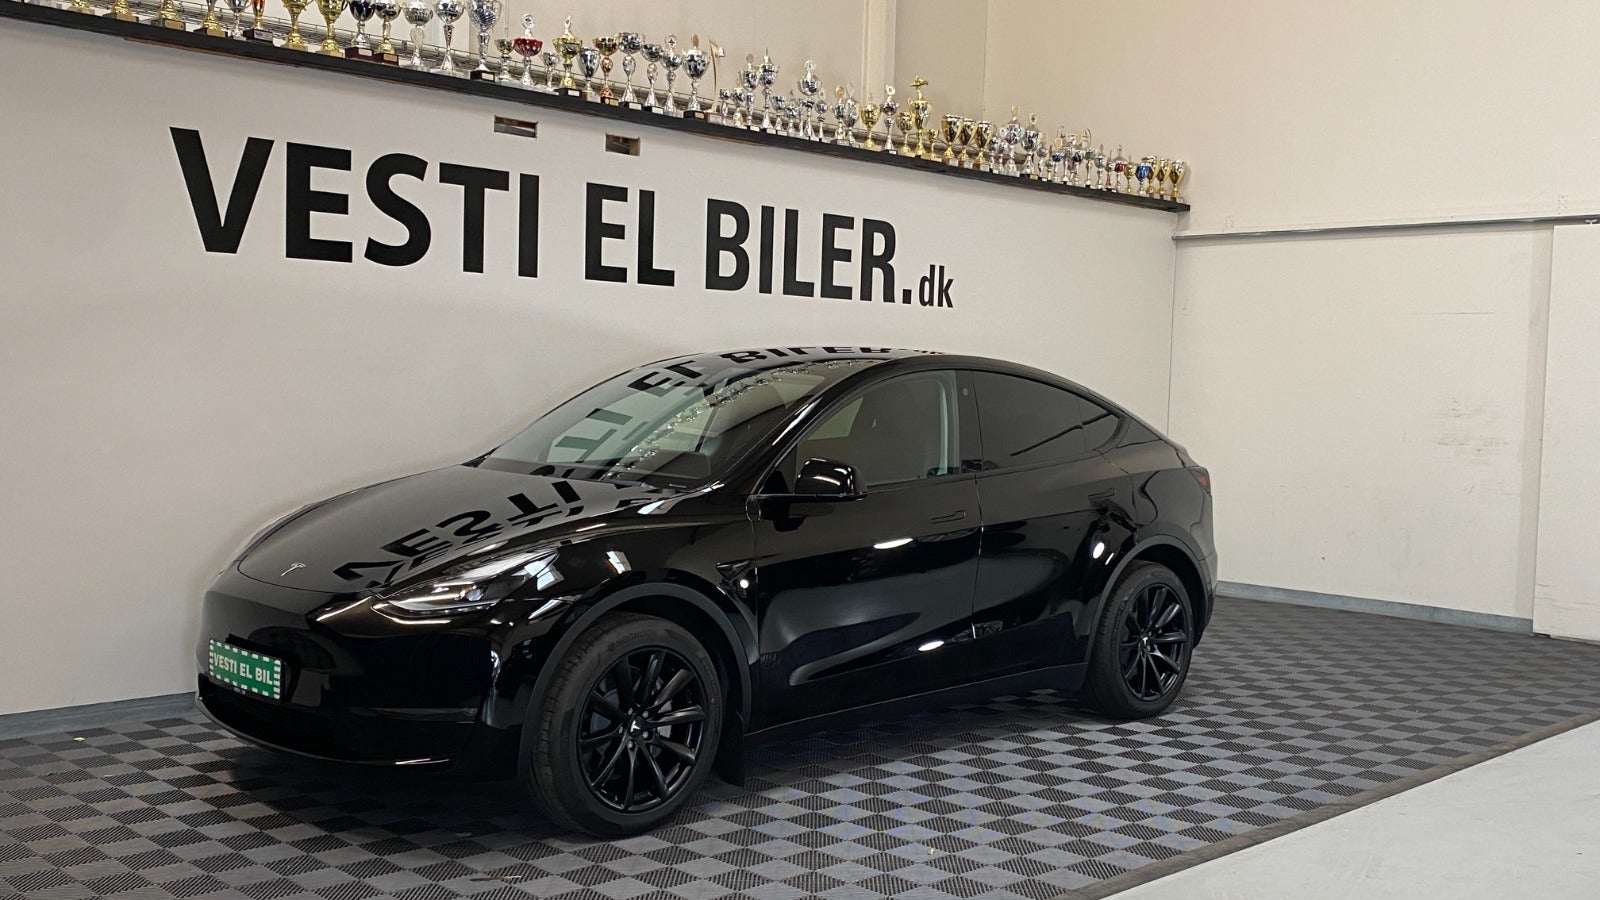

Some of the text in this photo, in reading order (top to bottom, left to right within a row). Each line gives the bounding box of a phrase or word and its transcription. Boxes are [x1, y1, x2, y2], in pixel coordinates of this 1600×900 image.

[169, 127, 954, 307] VESTI EL BILER.dk
[213, 652, 273, 685] VESTI EL BIL
